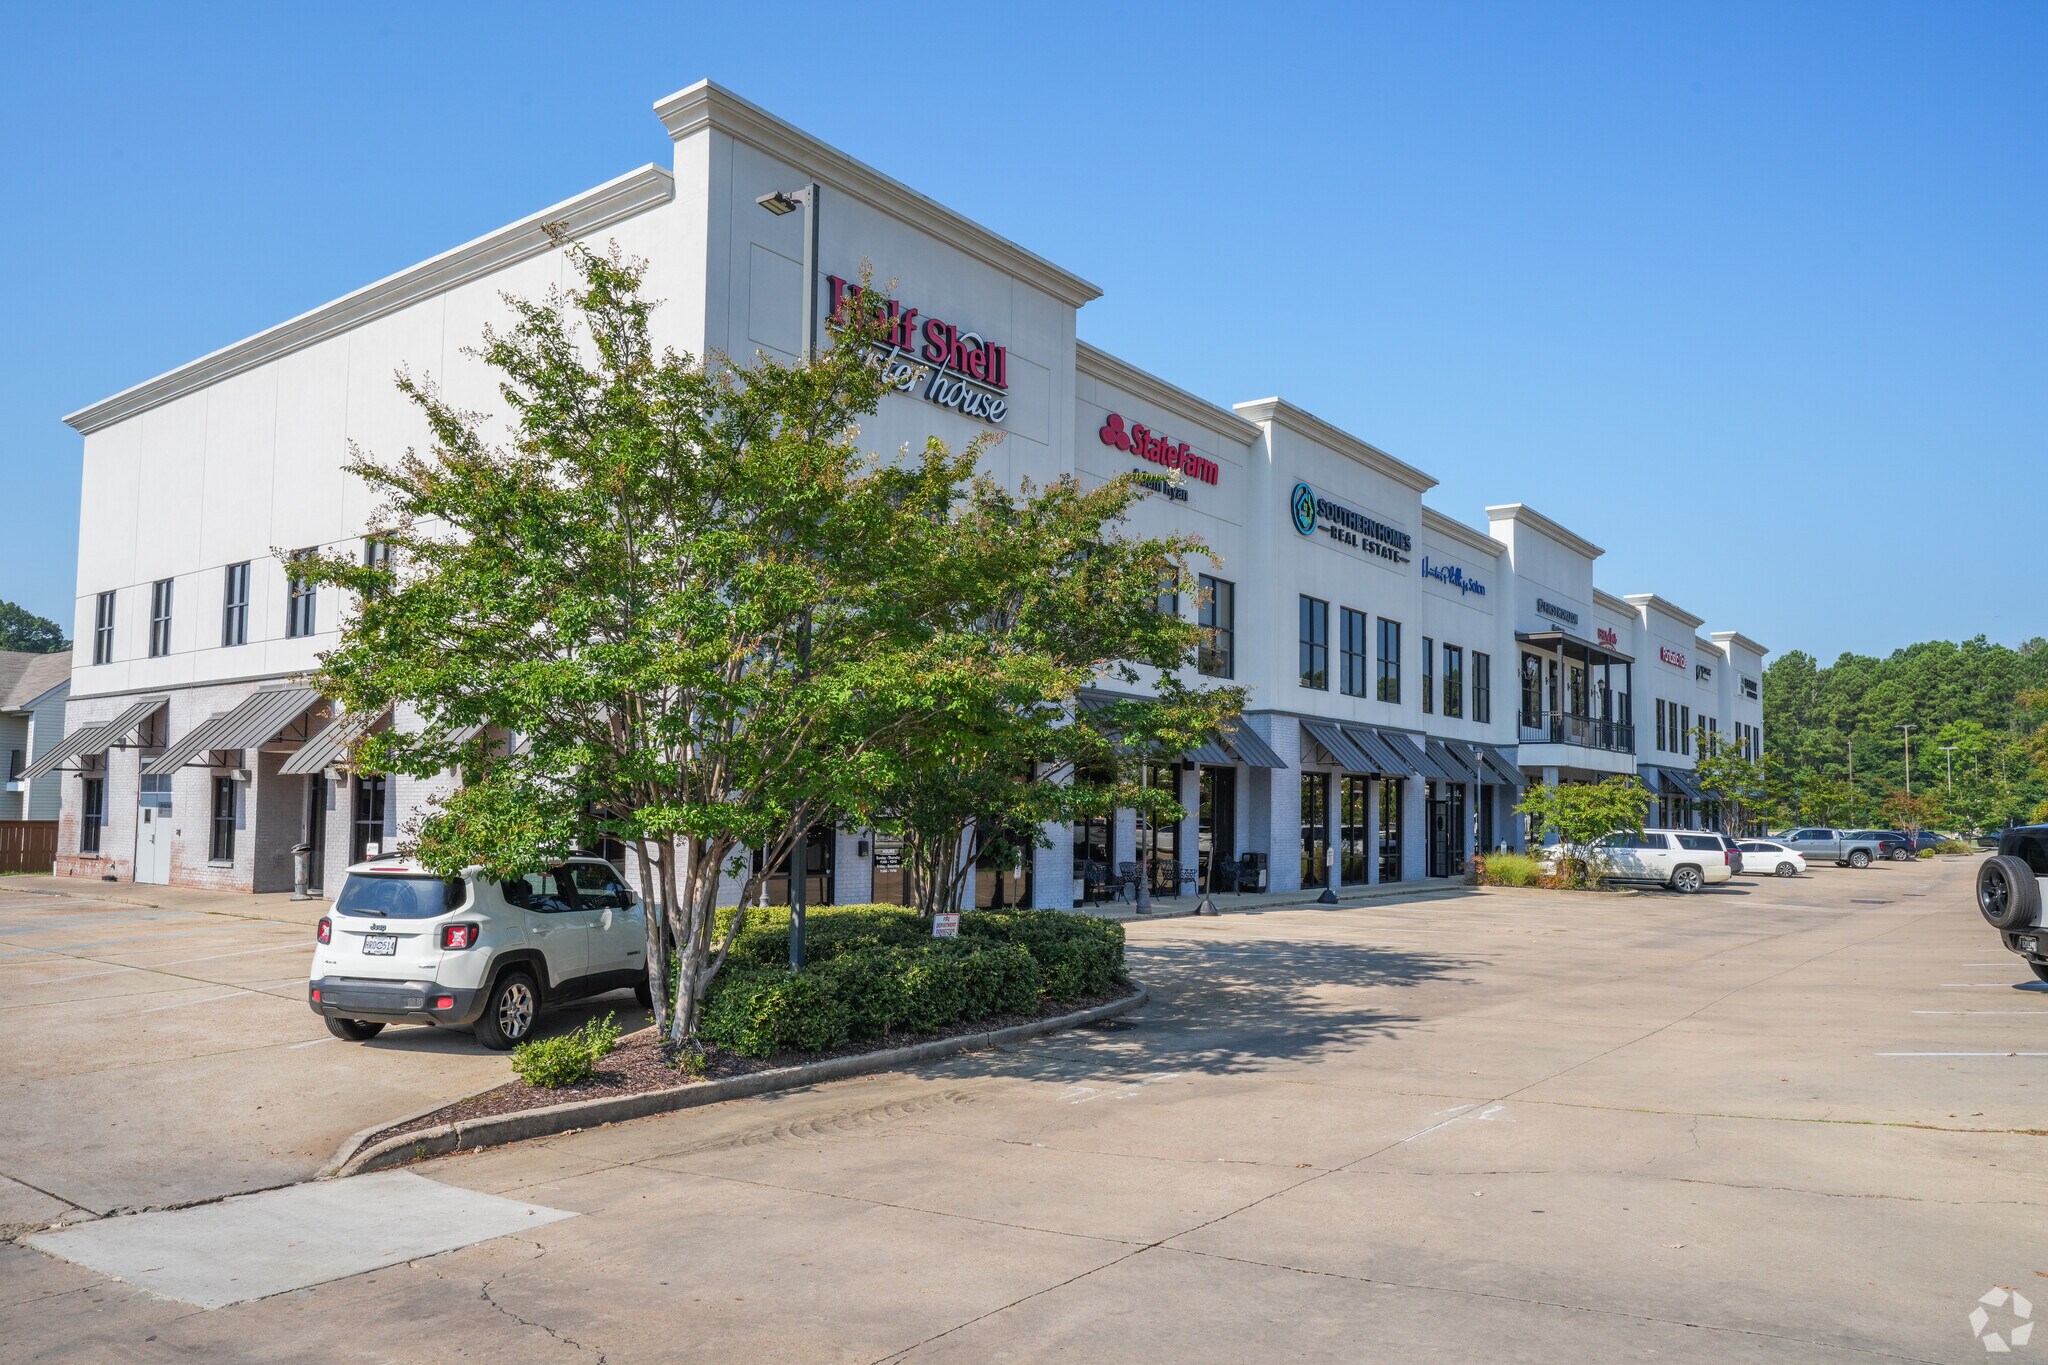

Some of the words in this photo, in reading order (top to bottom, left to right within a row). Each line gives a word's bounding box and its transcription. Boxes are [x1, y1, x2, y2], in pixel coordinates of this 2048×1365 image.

[922, 318, 1008, 389] Shell
[924, 353, 1009, 424] house
[1316, 498, 1378, 539] SOUTHERN
[1375, 522, 1411, 552] HOMES
[1330, 525, 1359, 548] REAL
[1361, 538, 1400, 563] ESTATE
[370, 923, 387, 931] Jeep
